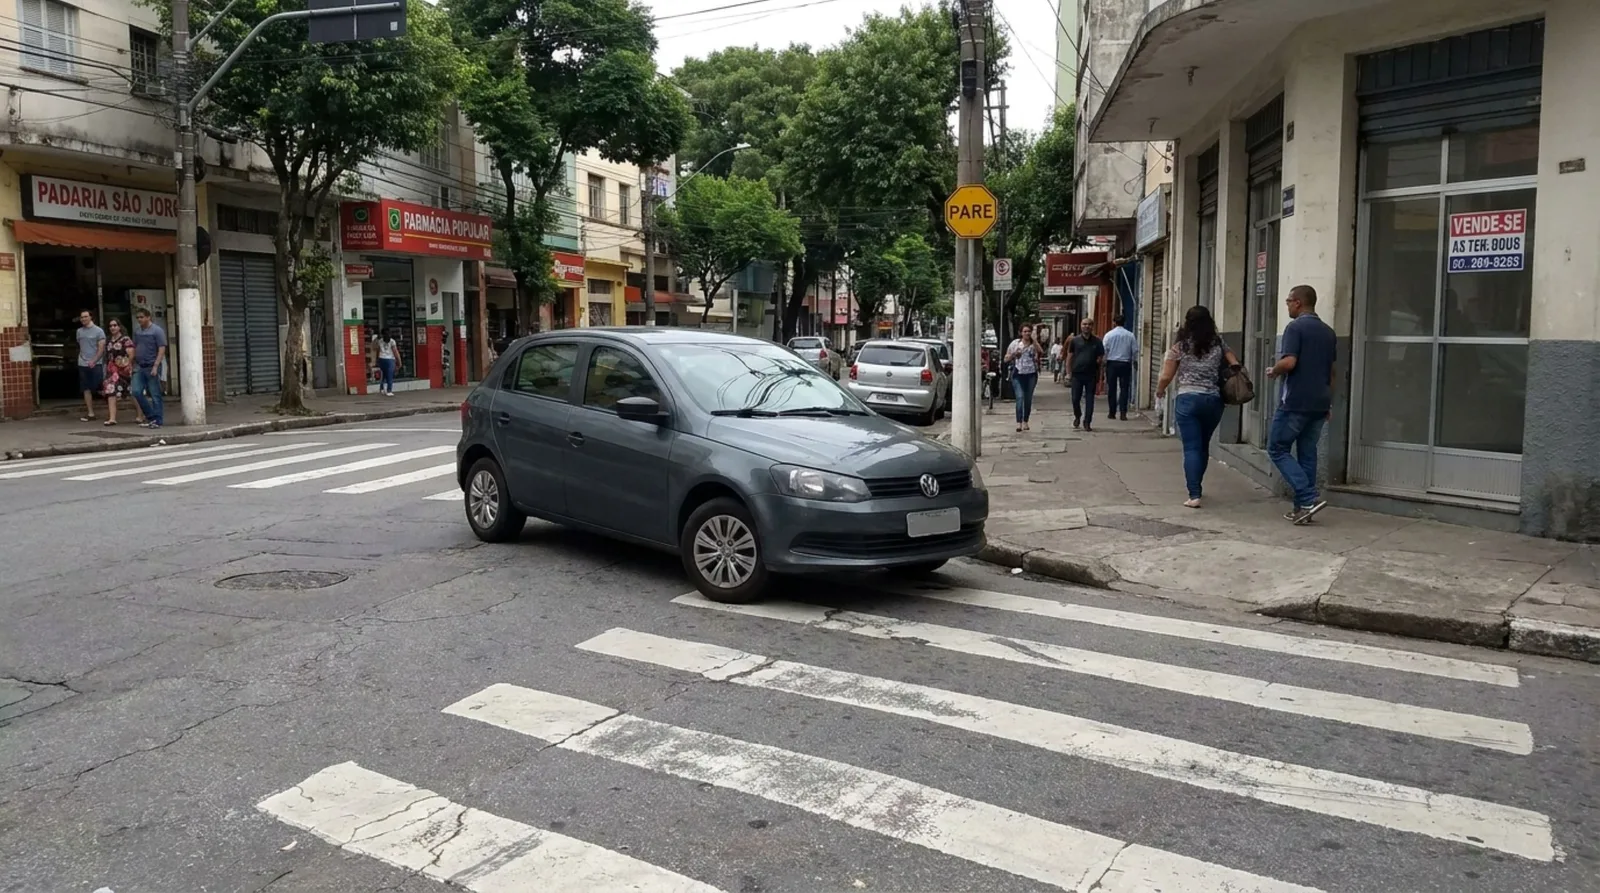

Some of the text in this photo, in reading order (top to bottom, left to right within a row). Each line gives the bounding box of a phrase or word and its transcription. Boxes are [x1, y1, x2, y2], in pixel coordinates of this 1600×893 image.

[38, 181, 108, 211] PADARIA
[949, 203, 993, 219] PARE
[1453, 213, 1522, 235] VENDE-SE
[1452, 240, 1466, 253] AS
